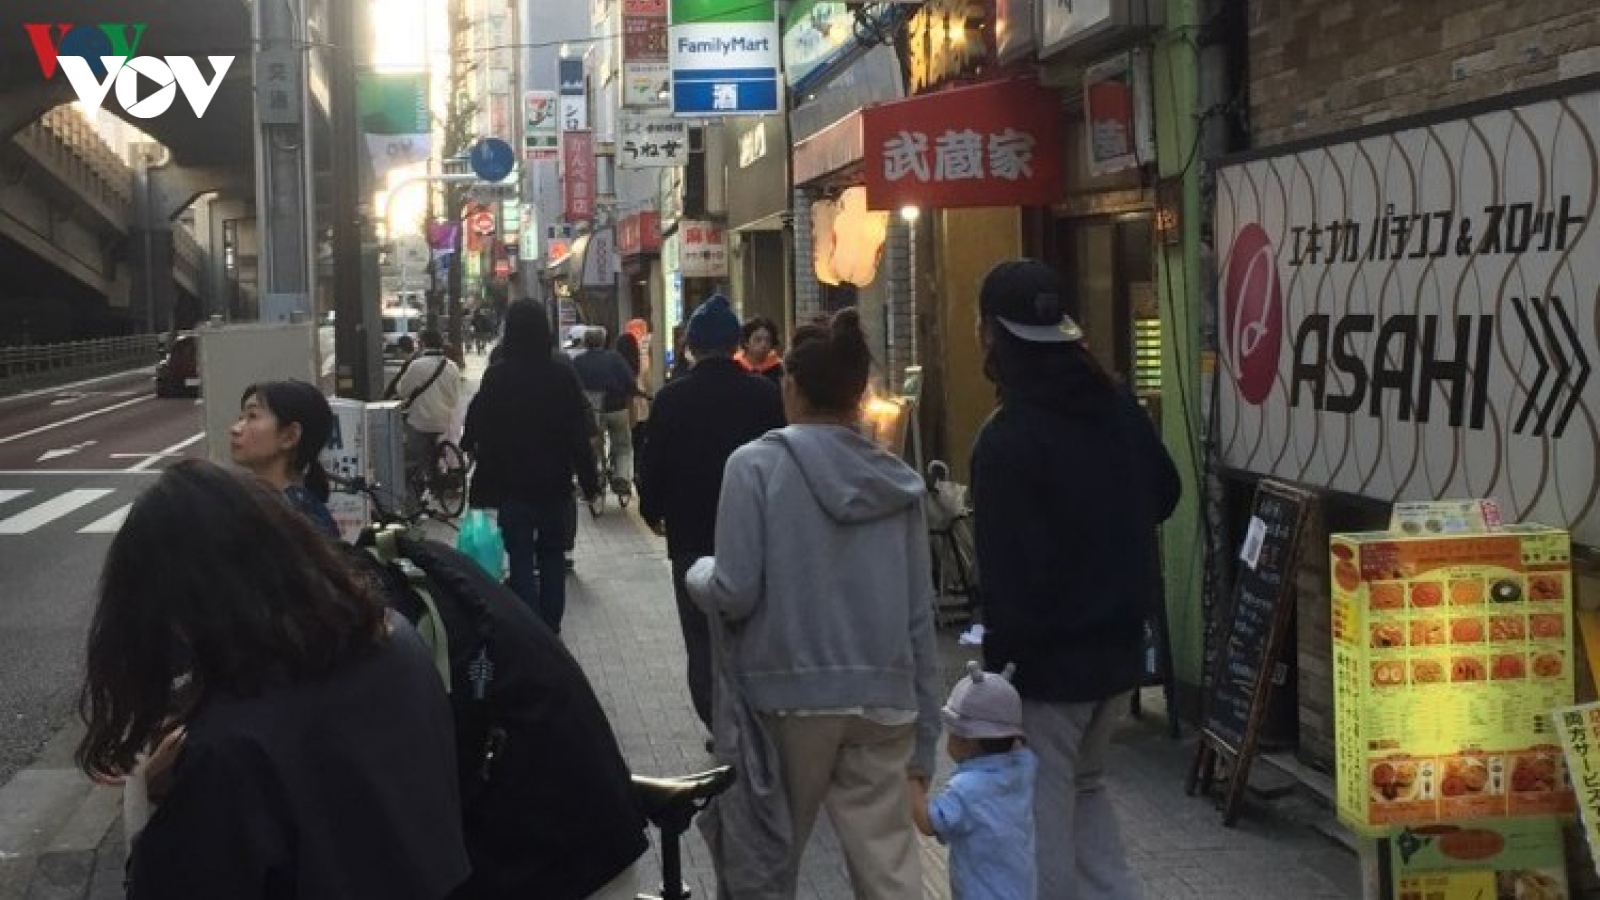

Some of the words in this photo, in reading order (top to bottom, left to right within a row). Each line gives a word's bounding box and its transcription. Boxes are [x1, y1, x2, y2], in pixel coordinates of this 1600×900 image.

[678, 36, 769, 55] FamilyMart
[714, 84, 738, 110] 酒
[882, 128, 1036, 183] 武蔵家
[1289, 218, 1359, 266] エキナカ
[1368, 204, 1452, 261] パチンコ
[1456, 217, 1473, 257] &
[1482, 195, 1586, 255] スロット
[1290, 314, 1494, 431] ASAHI
